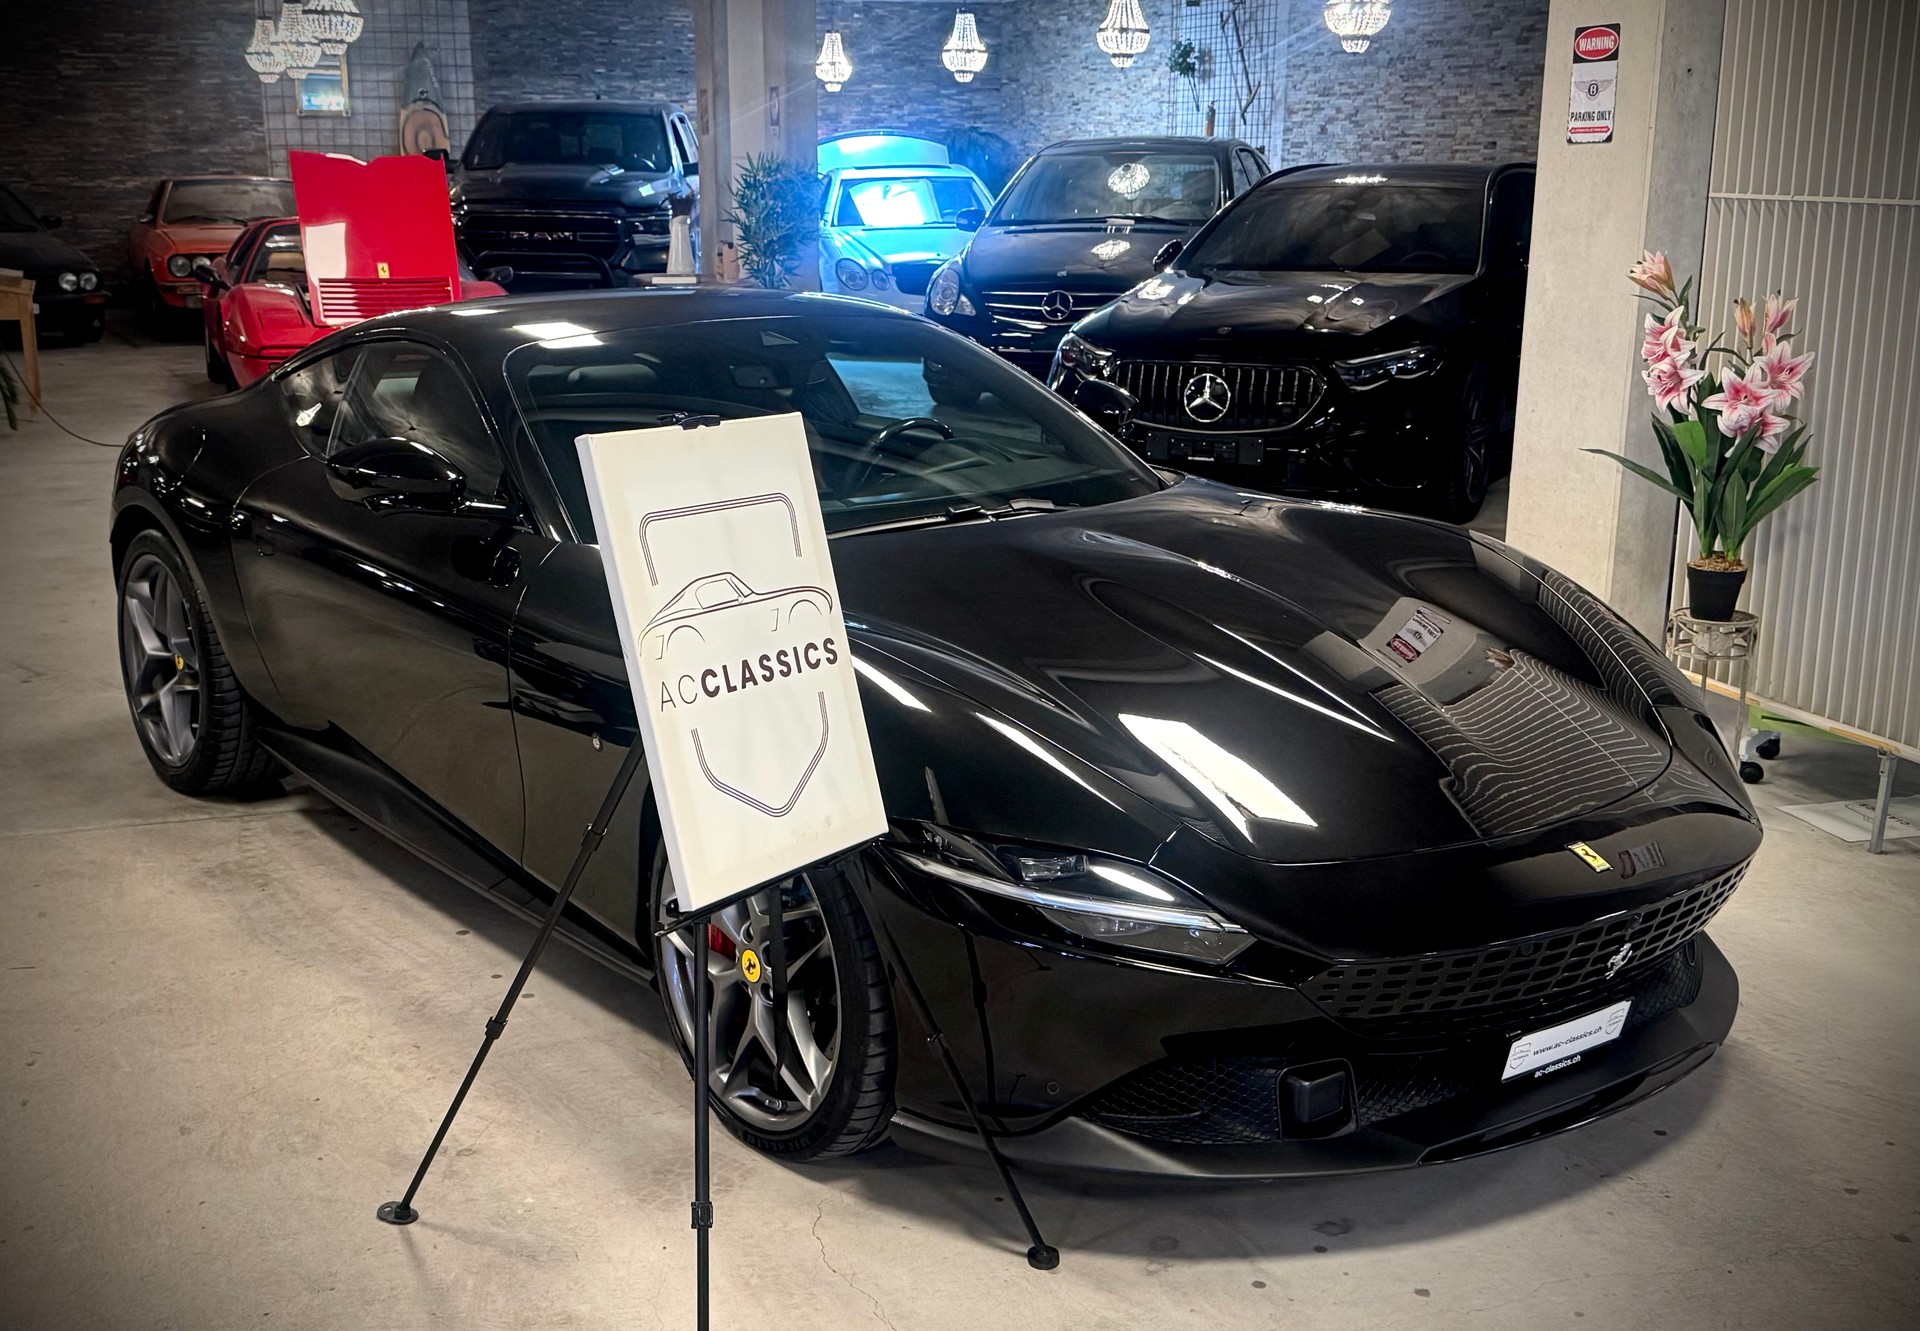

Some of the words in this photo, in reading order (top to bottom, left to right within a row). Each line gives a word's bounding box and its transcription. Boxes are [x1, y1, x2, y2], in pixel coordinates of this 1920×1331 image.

[1579, 36, 1615, 52] WARNING
[1570, 111, 1596, 122] PARKING
[1596, 110, 1612, 121] ONLY
[510, 231, 573, 241] RAM
[1533, 1025, 1603, 1057] www.ac-classics.ch
[1534, 1055, 1582, 1079] ac-classics.ch
